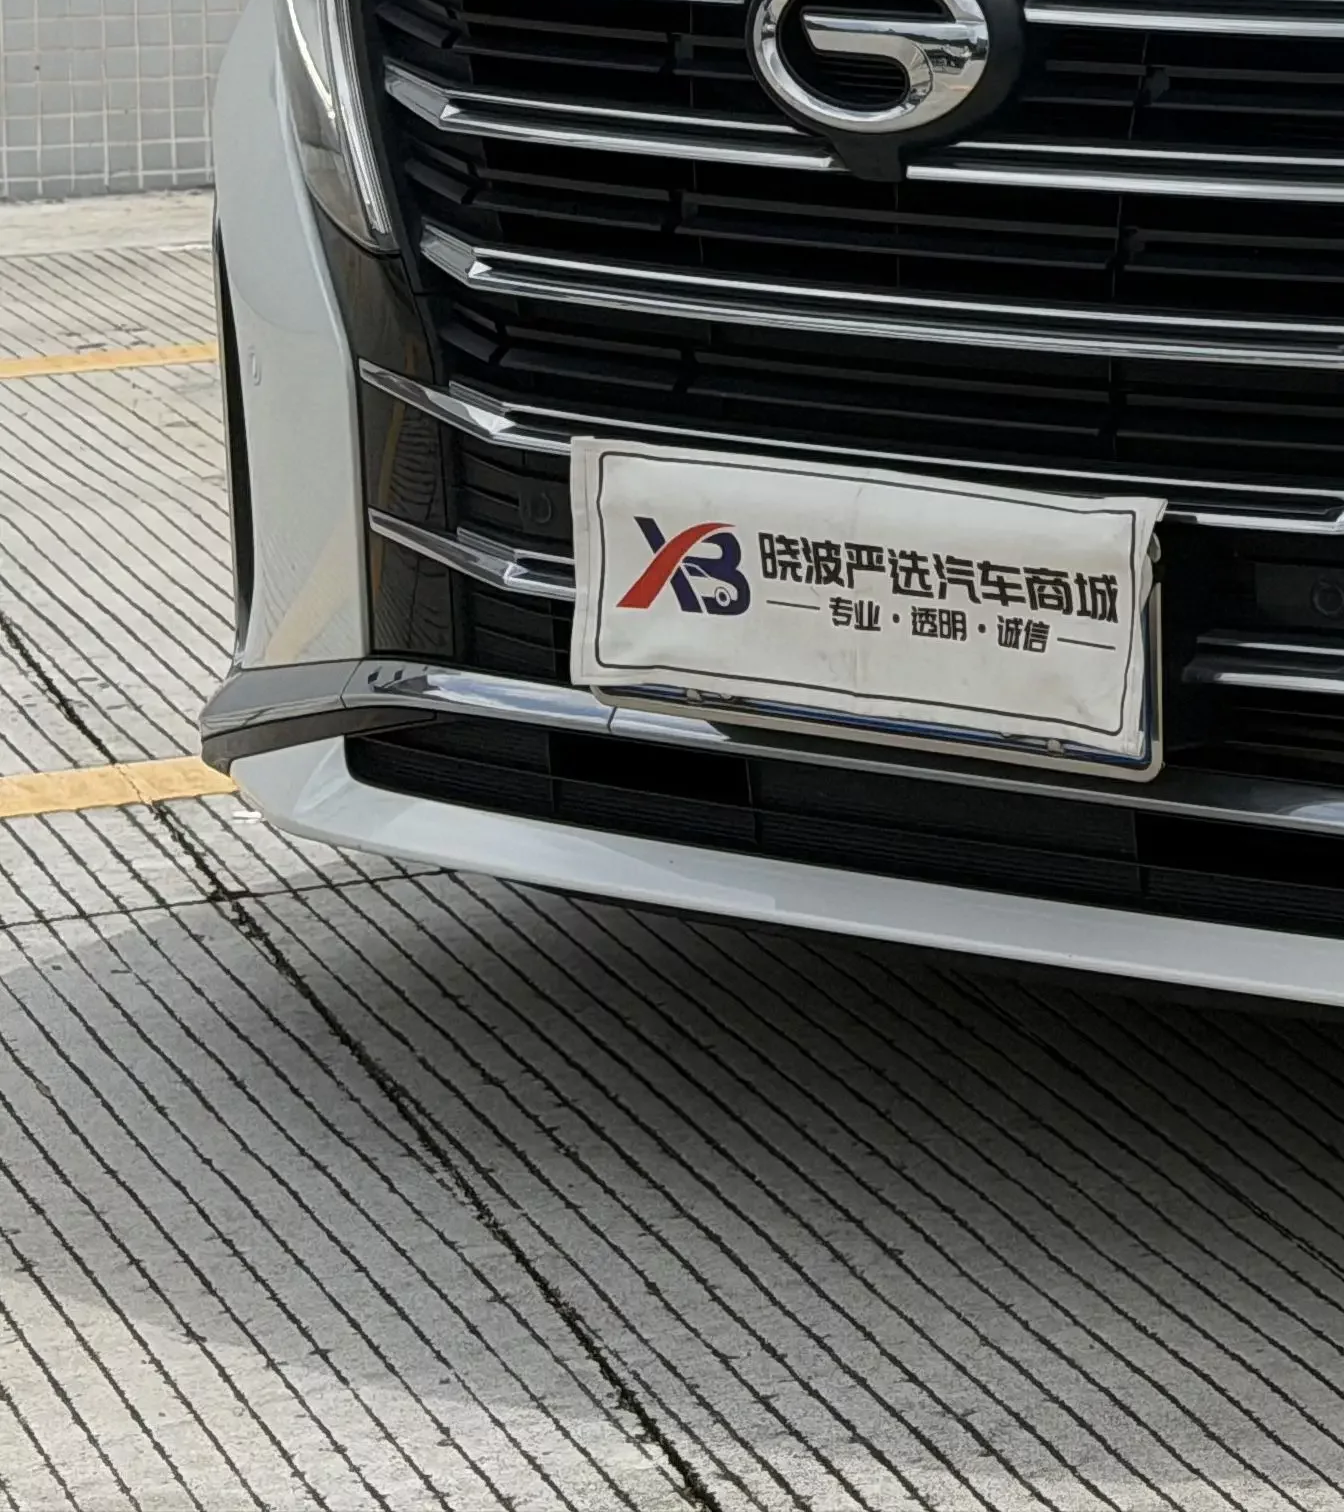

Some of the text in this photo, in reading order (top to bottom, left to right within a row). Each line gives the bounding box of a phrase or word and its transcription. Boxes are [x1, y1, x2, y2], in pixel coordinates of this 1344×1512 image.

[758, 532, 1118, 623] 晓波严选汽车商城
